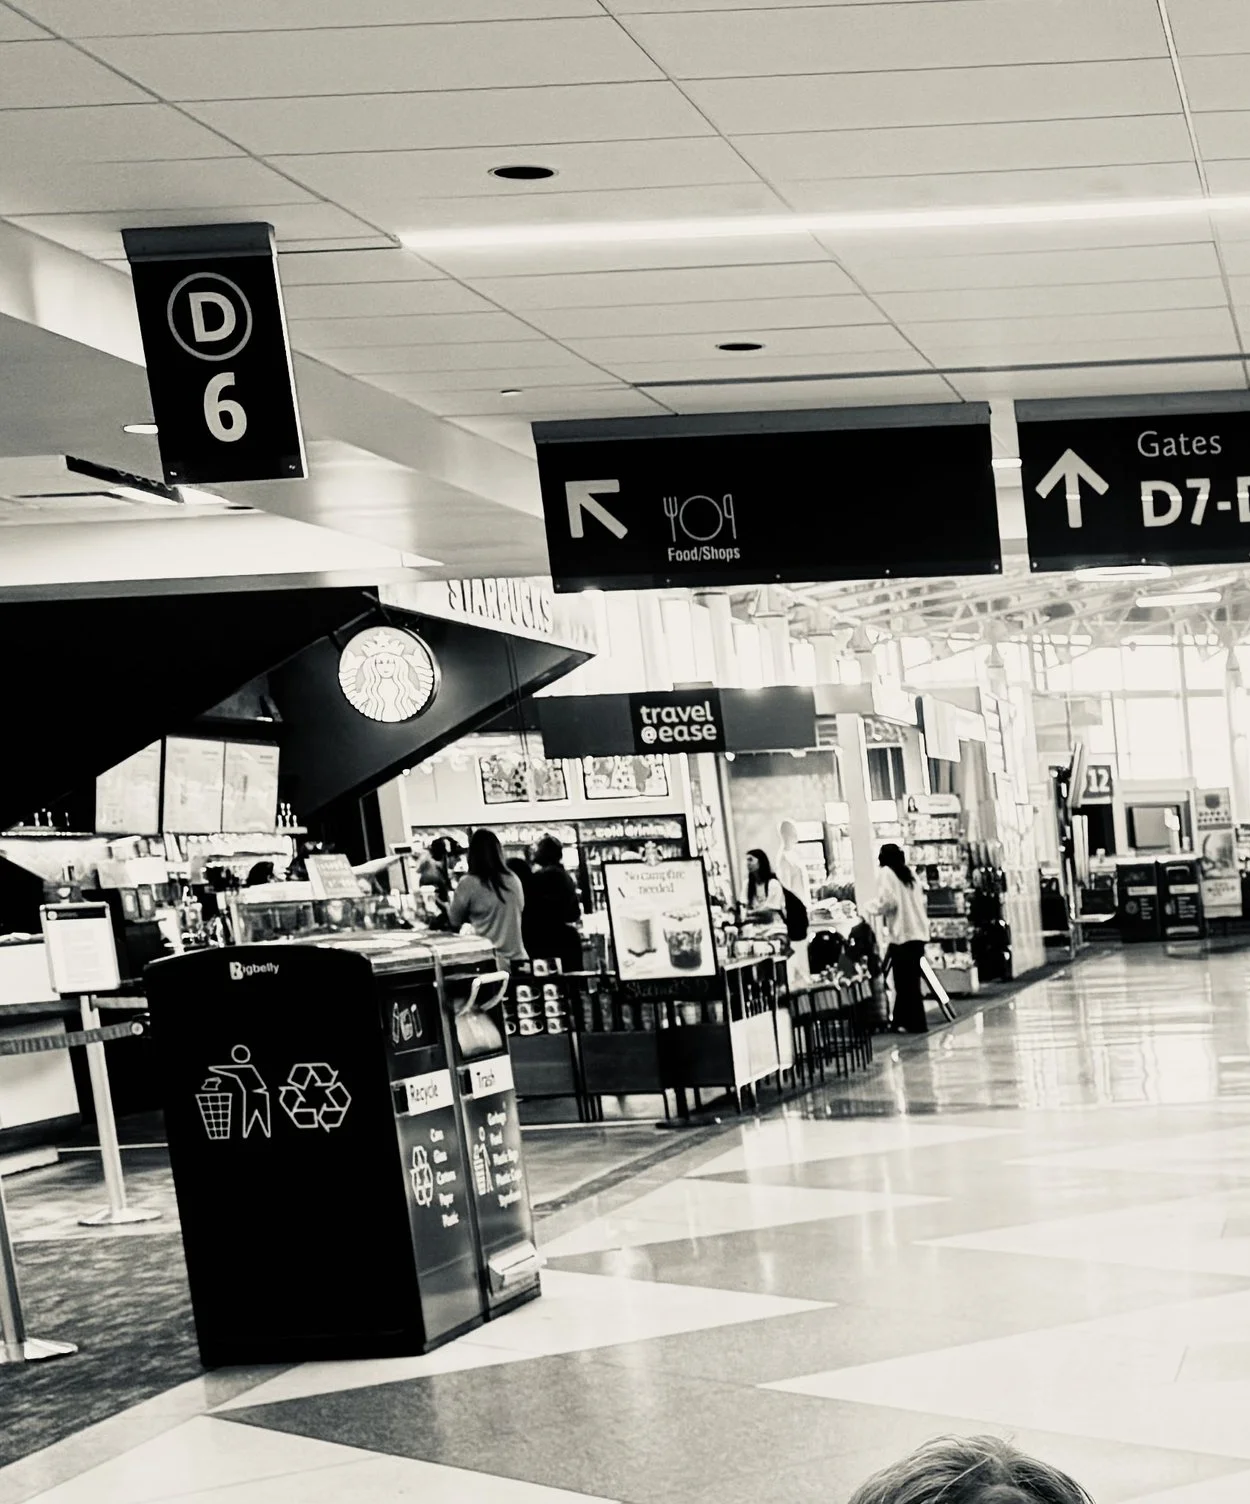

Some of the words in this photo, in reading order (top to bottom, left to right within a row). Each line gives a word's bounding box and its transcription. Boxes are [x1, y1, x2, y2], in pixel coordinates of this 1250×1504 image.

[188, 291, 237, 343] D
[203, 371, 248, 443] 6
[1136, 430, 1223, 458] Gates
[667, 545, 741, 563] Food/Shops
[639, 700, 714, 724] travel
[228, 960, 280, 981] Bigbelly
